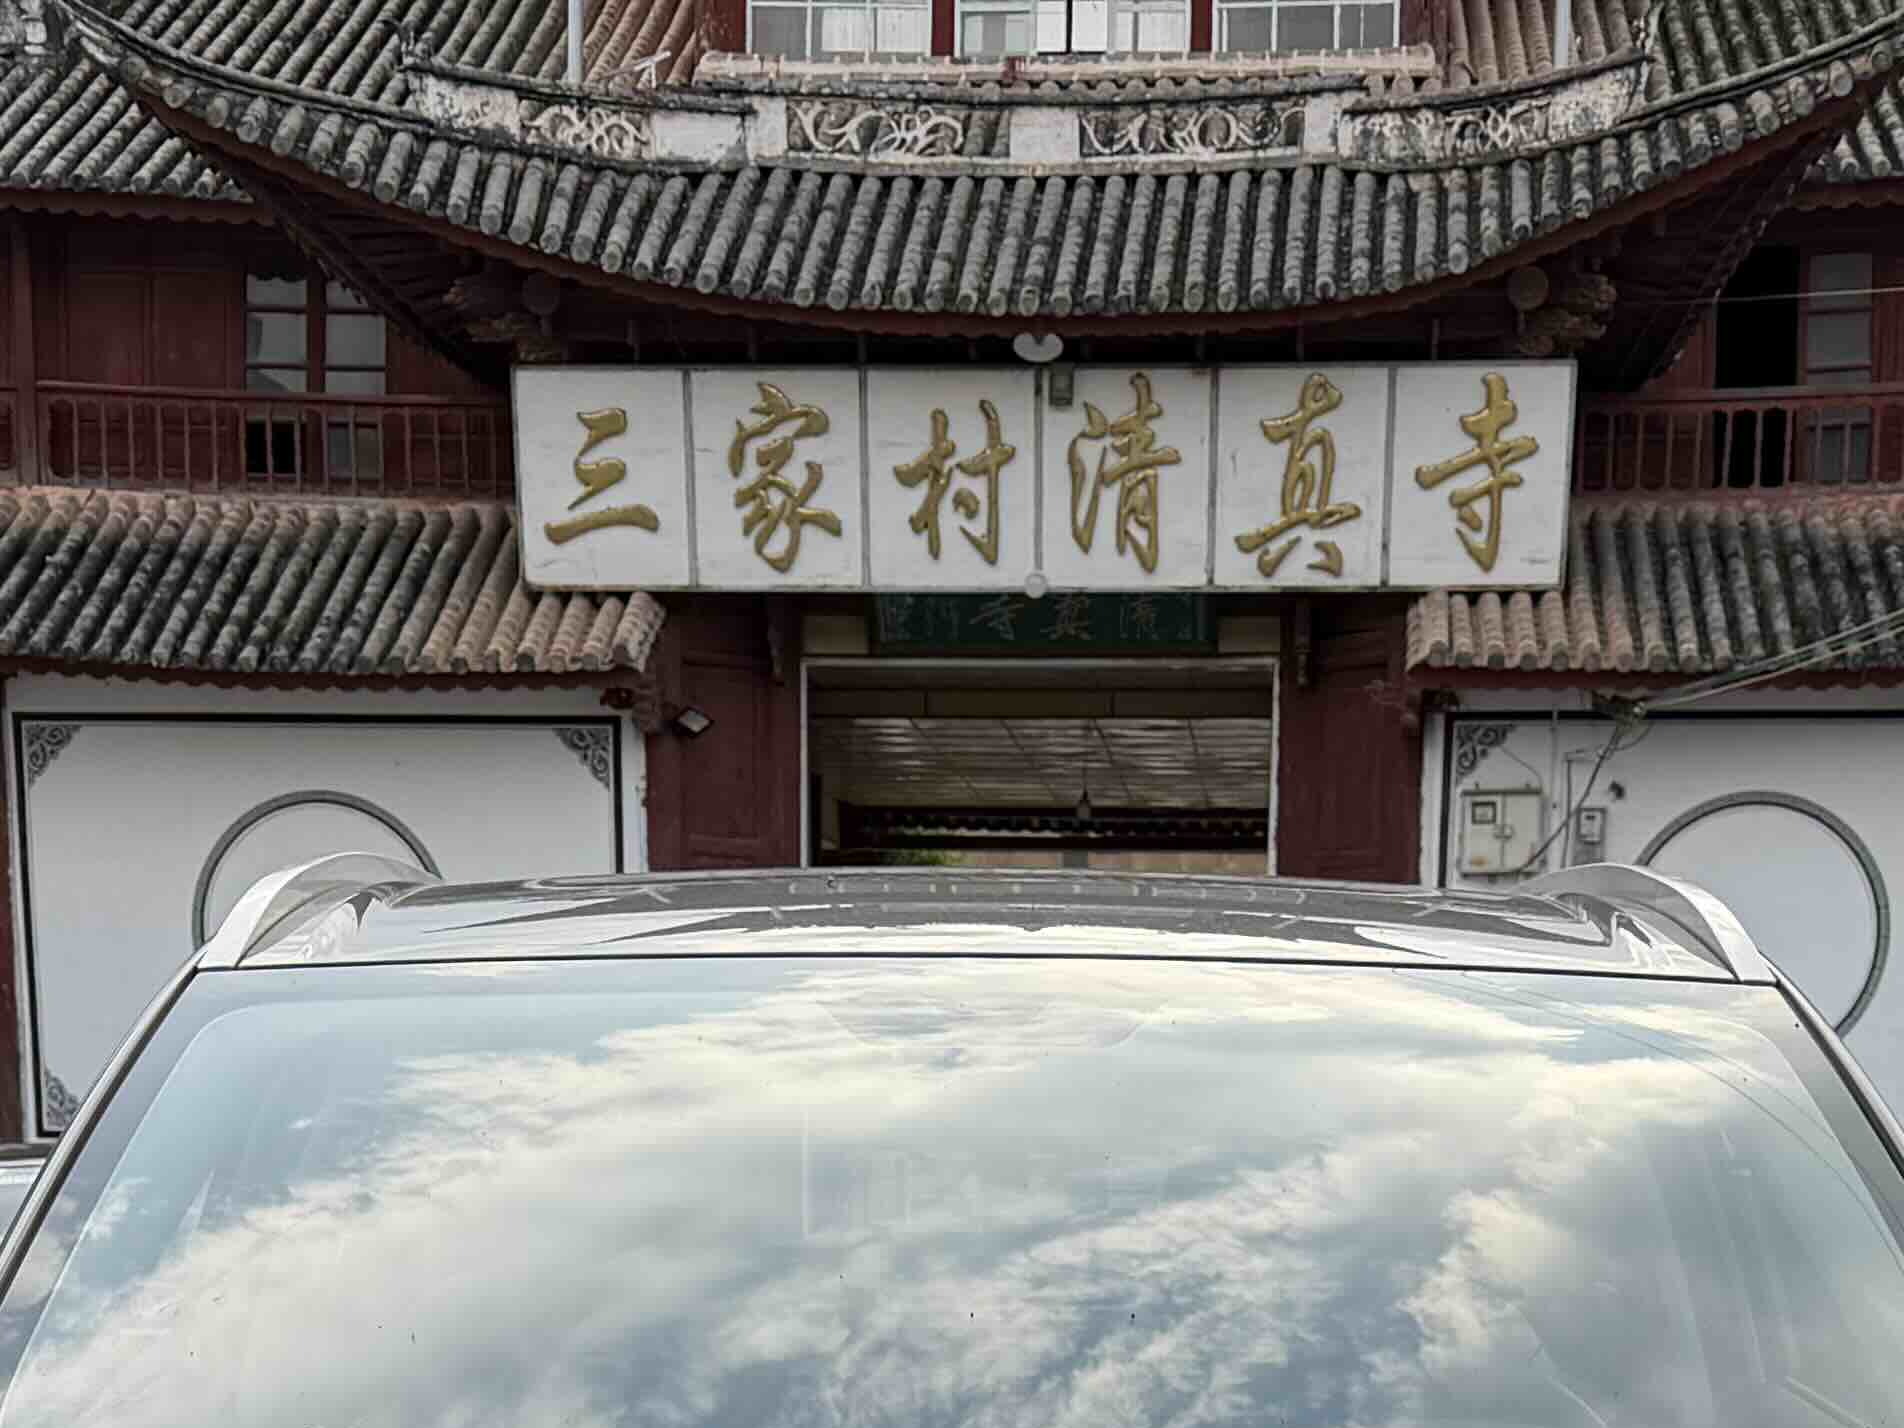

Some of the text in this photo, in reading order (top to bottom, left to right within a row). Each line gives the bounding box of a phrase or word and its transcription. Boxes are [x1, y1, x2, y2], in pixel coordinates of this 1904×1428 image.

[543, 371, 1541, 577] 三家村清真寺
